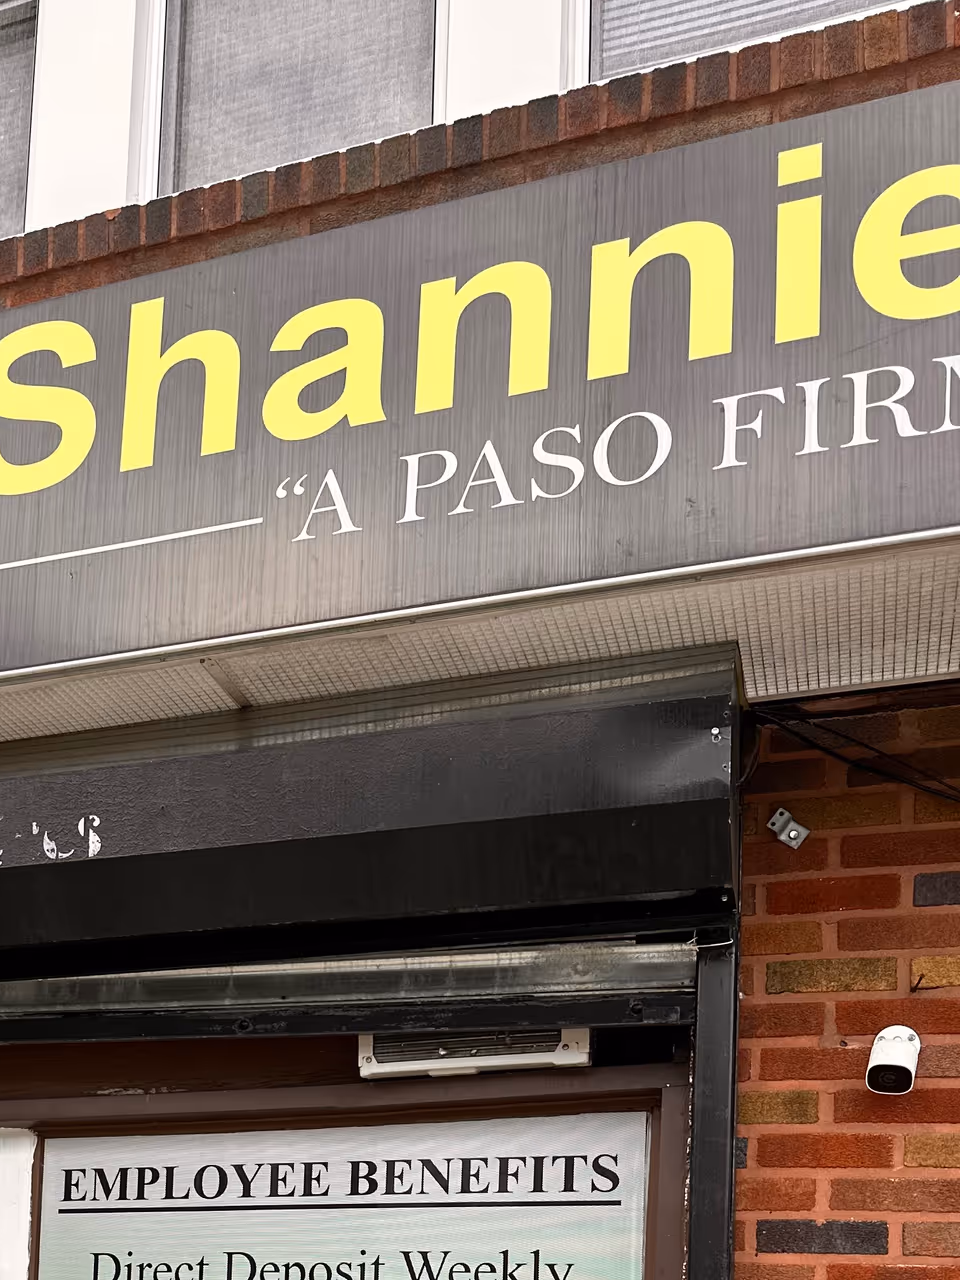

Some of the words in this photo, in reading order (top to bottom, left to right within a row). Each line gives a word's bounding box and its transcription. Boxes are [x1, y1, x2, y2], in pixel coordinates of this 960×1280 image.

[395, 412, 673, 523] PASO
[61, 1161, 330, 1202] EMPLOYEE
[347, 1153, 621, 1197] BENEFITS
